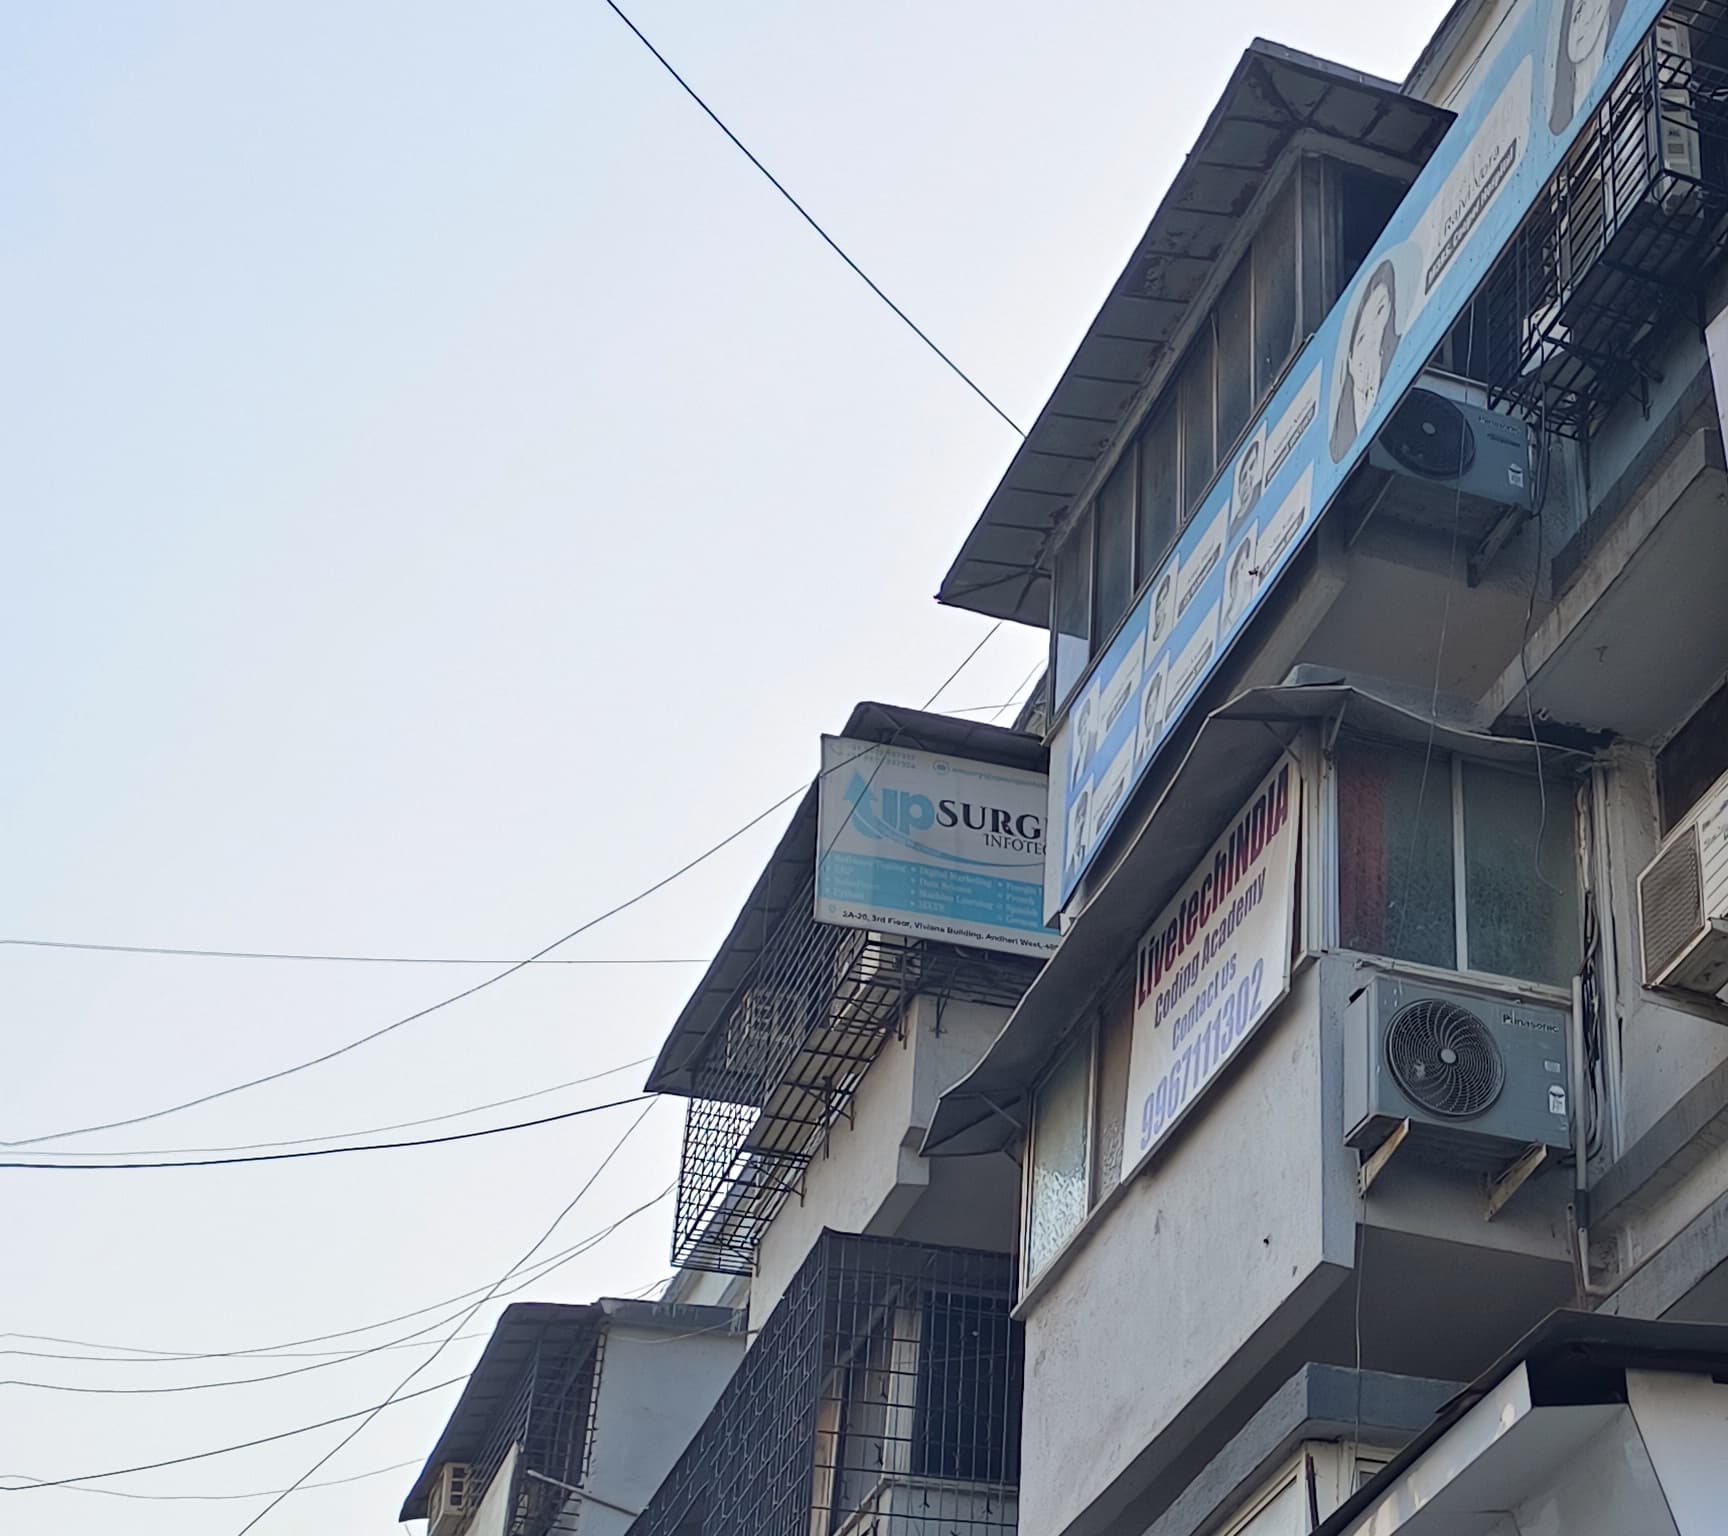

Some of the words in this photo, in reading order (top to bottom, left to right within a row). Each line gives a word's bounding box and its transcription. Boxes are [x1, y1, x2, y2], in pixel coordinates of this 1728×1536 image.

[1153, 950, 1200, 1029] Coding
[1200, 866, 1267, 971] Academy
[1171, 986, 1219, 1052] Contact
[1221, 952, 1238, 992] us
